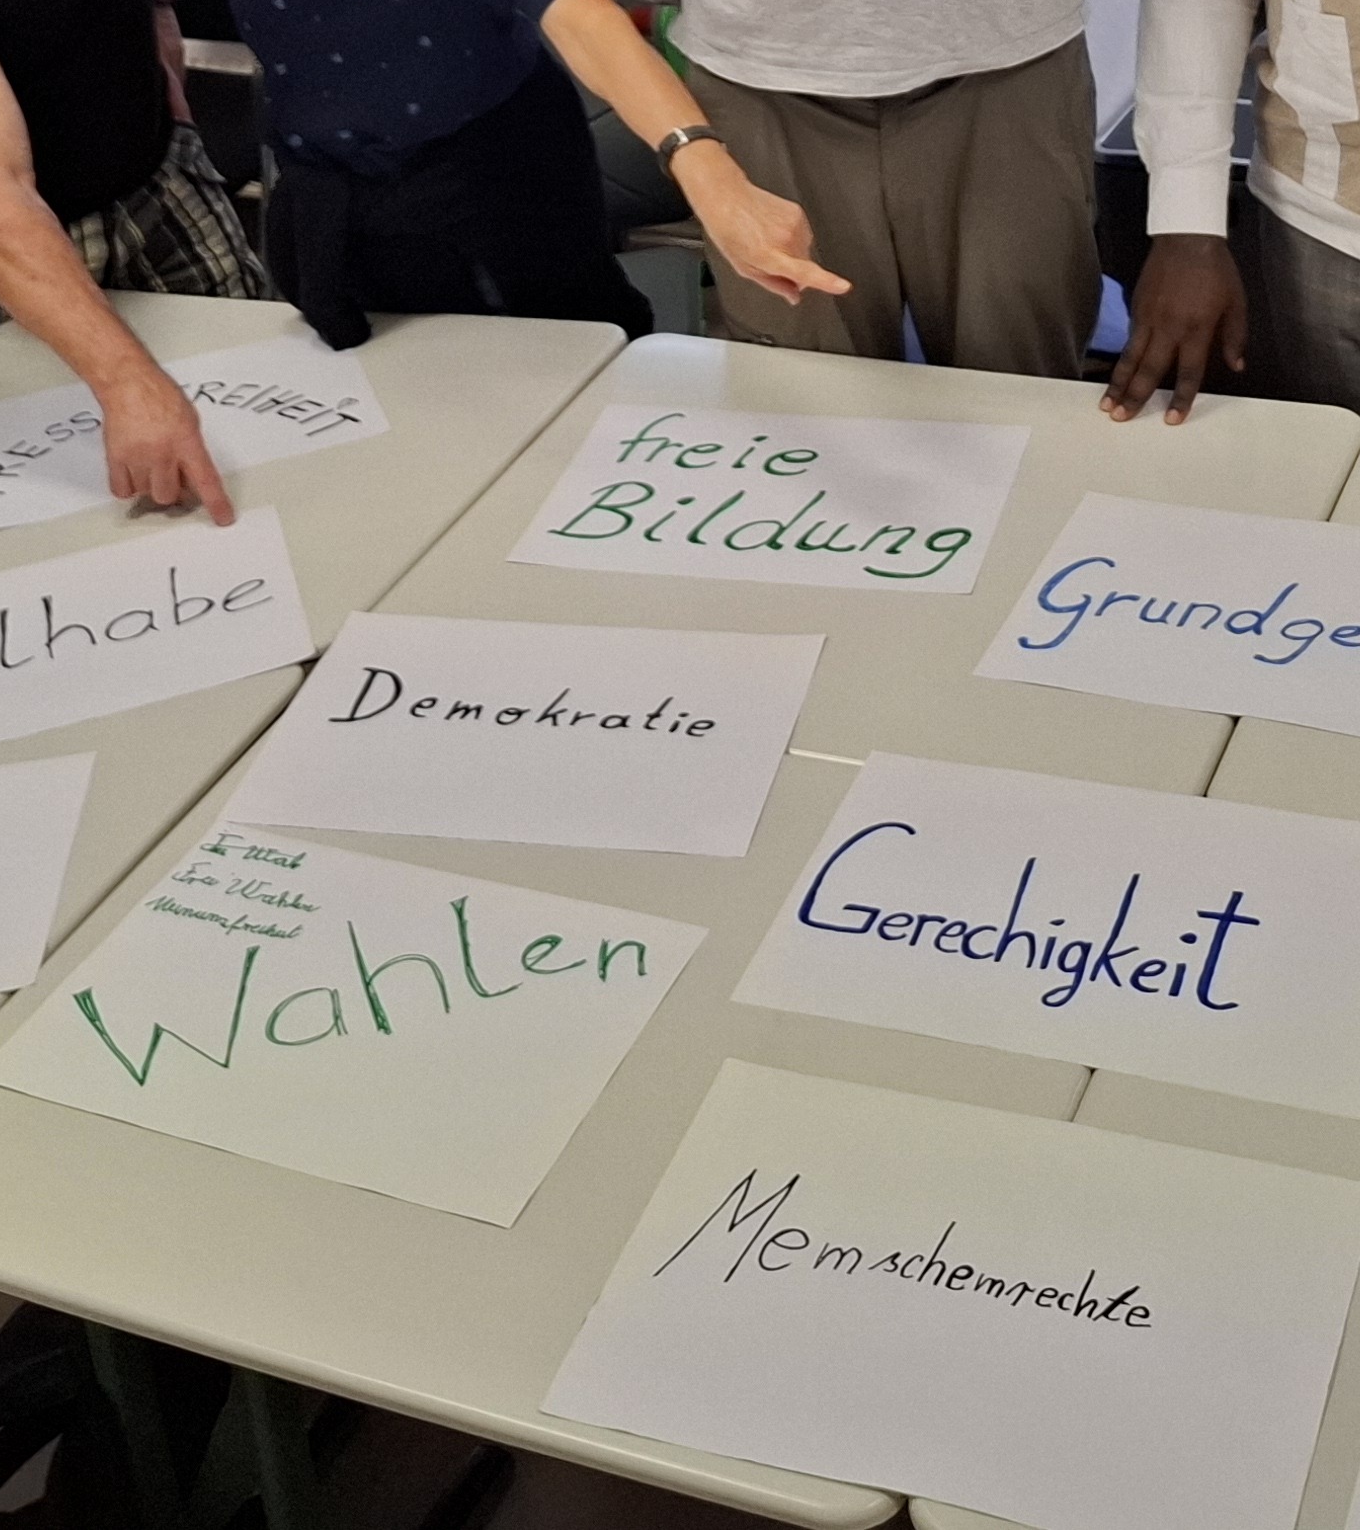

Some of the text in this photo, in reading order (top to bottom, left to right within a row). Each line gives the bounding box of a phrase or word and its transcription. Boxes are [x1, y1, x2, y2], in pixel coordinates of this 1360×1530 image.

[615, 413, 818, 476] freie
[548, 480, 973, 579] Bildung
[328, 667, 717, 738] Demokratie
[797, 820, 1261, 1011] Gerechigkeit
[73, 895, 648, 1087] Wahlen
